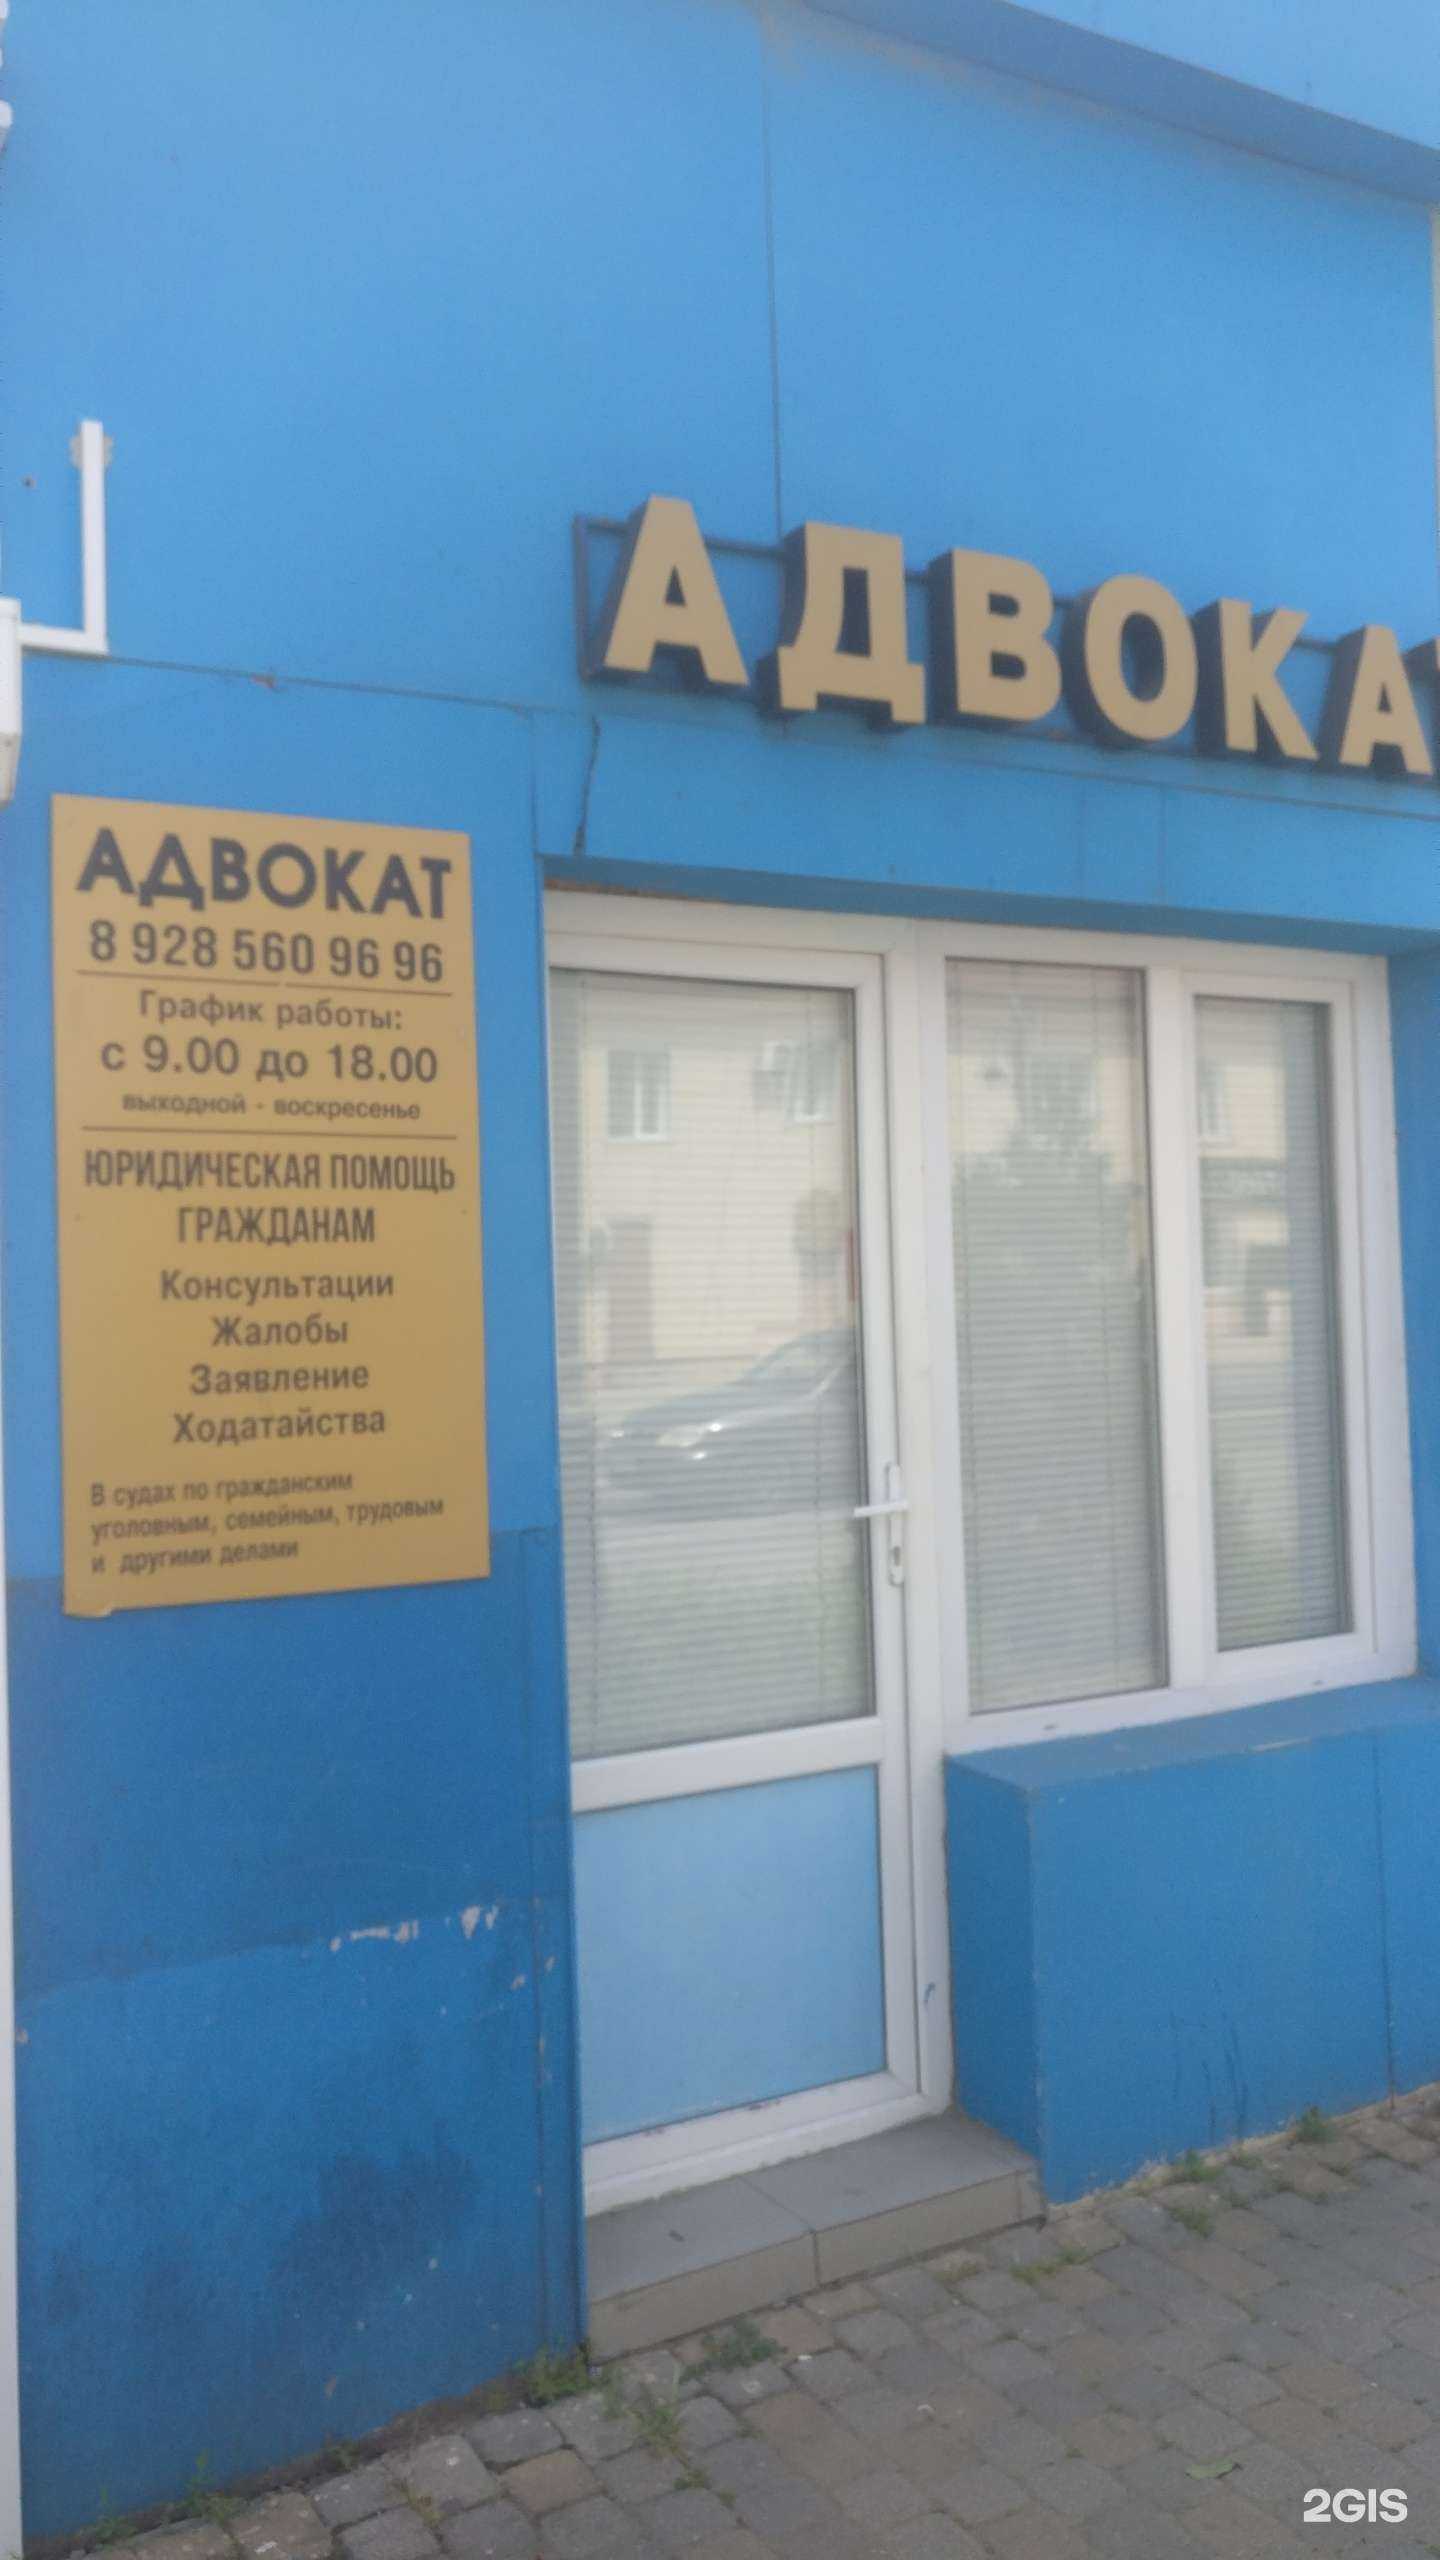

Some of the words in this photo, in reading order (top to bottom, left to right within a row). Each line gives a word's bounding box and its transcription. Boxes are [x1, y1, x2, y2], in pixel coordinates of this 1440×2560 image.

[602, 493, 1440, 776] АДВОКА
[75, 827, 452, 920] АДВОКАТ
[90, 919, 117, 962] 8
[132, 922, 218, 968] 928
[232, 929, 315, 975] 560
[328, 936, 380, 979] 96
[393, 941, 443, 983] 96
[138, 990, 263, 1026] График
[277, 997, 402, 1030] работы:
[143, 1034, 240, 1075] 9.00
[255, 1049, 309, 1082] до
[328, 1044, 438, 1083] 18.00
[122, 1093, 247, 1115] выходной
[273, 1099, 421, 1121] воскресенье
[84, 1149, 321, 1190] ЮРИДИЧЕСКАЯ
[330, 1154, 456, 1194] ПОМОЩЬ
[178, 1206, 376, 1246] ГРАЖДАНАМ
[161, 1269, 395, 1305] Консультации
[211, 1313, 349, 1347] Жалобы
[189, 1364, 370, 1396] Заявление
[173, 1408, 386, 1446] Ходатайства
[90, 1484, 105, 1506] В
[113, 1484, 175, 1510] судах
[183, 1482, 209, 1502] по
[215, 1472, 353, 1501] гражданским
[91, 1517, 218, 1546] уголовным,
[225, 1506, 341, 1532] семейным,
[346, 1498, 444, 1523] трудовым
[91, 1556, 105, 1574] и
[119, 1544, 212, 1575] другими
[219, 1539, 299, 1565] делами
